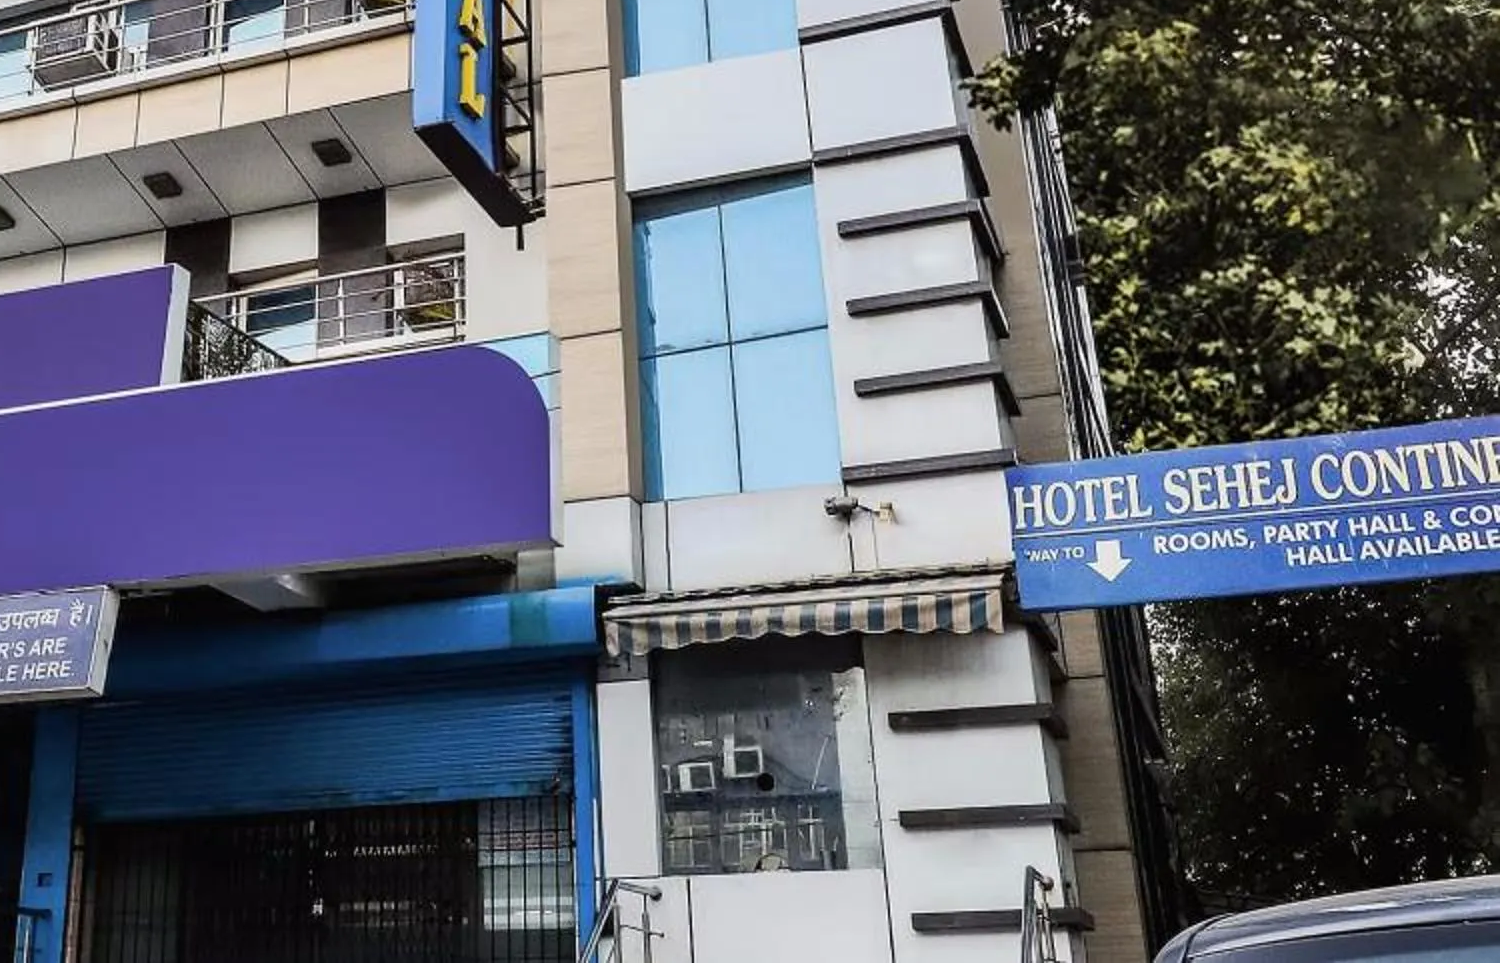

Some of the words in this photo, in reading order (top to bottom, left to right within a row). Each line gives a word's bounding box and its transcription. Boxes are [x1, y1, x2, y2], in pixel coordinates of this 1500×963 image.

[1013, 475, 1153, 529] HOTEL
[1163, 458, 1297, 514] SEHEJ
[1153, 528, 1256, 554] ROOMS,
[1264, 519, 1339, 544] PARTY
[1348, 513, 1416, 537] HALL
[1423, 510, 1442, 530] &
[1062, 546, 1085, 558] TO
[1287, 543, 1352, 566] HALL
[1360, 528, 1500, 560] AVAILABLE
[28, 637, 67, 656] ARE
[22, 661, 75, 681] HERE.
